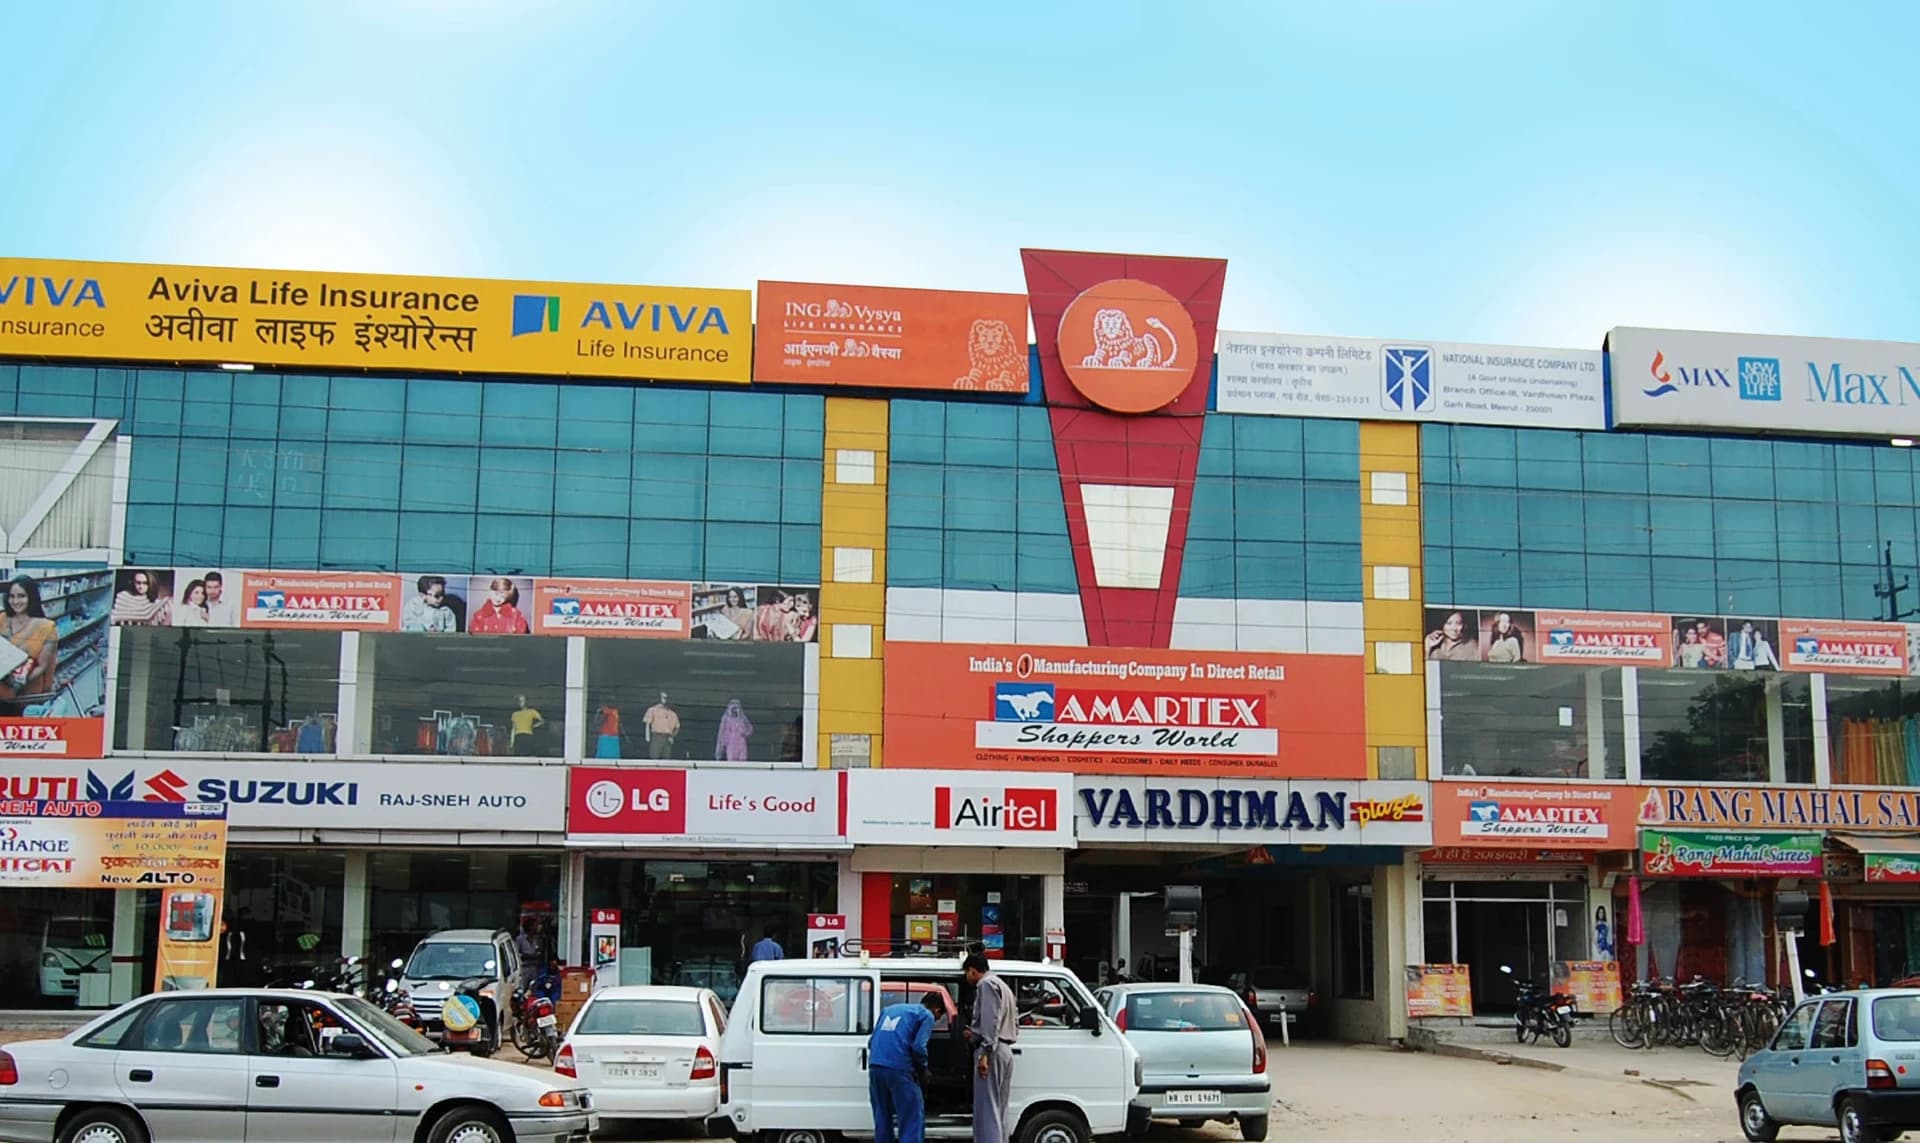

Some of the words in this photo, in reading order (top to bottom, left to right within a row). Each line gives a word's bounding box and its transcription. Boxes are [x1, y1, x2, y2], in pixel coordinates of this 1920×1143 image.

[148, 277, 238, 304] Aviva
[249, 281, 309, 307] Life
[319, 283, 479, 313] Insurance
[580, 300, 730, 334] AVIVA
[785, 302, 821, 318] ING
[855, 305, 901, 323] Vysya
[145, 307, 239, 344] अवीवा
[255, 315, 336, 349] लाइफ
[576, 338, 615, 359] Life
[623, 340, 729, 364] Insurance
[1443, 353, 1484, 365] NATIONAL
[1487, 357, 1535, 369] INSURANCE
[1537, 359, 1577, 371] COMPANY
[1744, 361, 1774, 374] NEW
[1678, 367, 1731, 388] MAX
[1740, 372, 1778, 386] YORK
[1806, 361, 1892, 405] Max
[1746, 384, 1775, 397] LIFE
[286, 595, 381, 610] AMARTEX
[581, 603, 674, 617] AMARTEX
[267, 609, 324, 621] Shoppers
[329, 610, 370, 620] World
[562, 615, 619, 627] Shoppers
[624, 617, 664, 627] World
[1574, 633, 1654, 647] AMARTEX
[1819, 642, 1895, 657] AMARTEX
[969, 656, 1012, 672] India's
[1034, 658, 1128, 680] Manufacturing
[1128, 661, 1187, 682] Company
[1191, 663, 1204, 678] In
[1207, 664, 1245, 679] Direct
[1248, 665, 1285, 680] Retail
[1057, 694, 1260, 727] AMARTEX
[4, 741, 48, 750] World
[1016, 726, 1142, 749] Shoppers
[1152, 729, 1239, 749] World
[197, 778, 358, 806] SUZUKI
[380, 793, 469, 807] RAJ-SNEH
[478, 795, 526, 808] AUTO
[631, 788, 670, 811] LG
[708, 794, 757, 811] Life's
[763, 796, 816, 813] Good
[42, 800, 101, 816] AUTO
[954, 797, 1046, 828] Airtel
[1078, 788, 1348, 831] VARDHMAN
[1357, 792, 1421, 829] plaza
[1500, 807, 1599, 823] AMARTEX
[1667, 788, 1751, 824] RANG
[1762, 790, 1869, 826] MAHAL
[1481, 821, 1541, 835] Shoppers
[1546, 824, 1589, 834] World
[1676, 846, 1713, 867] Rang
[1718, 844, 1764, 862] Mahal
[1768, 848, 1811, 862] Sarees
[101, 874, 132, 883] New
[136, 872, 194, 883] ALTO
